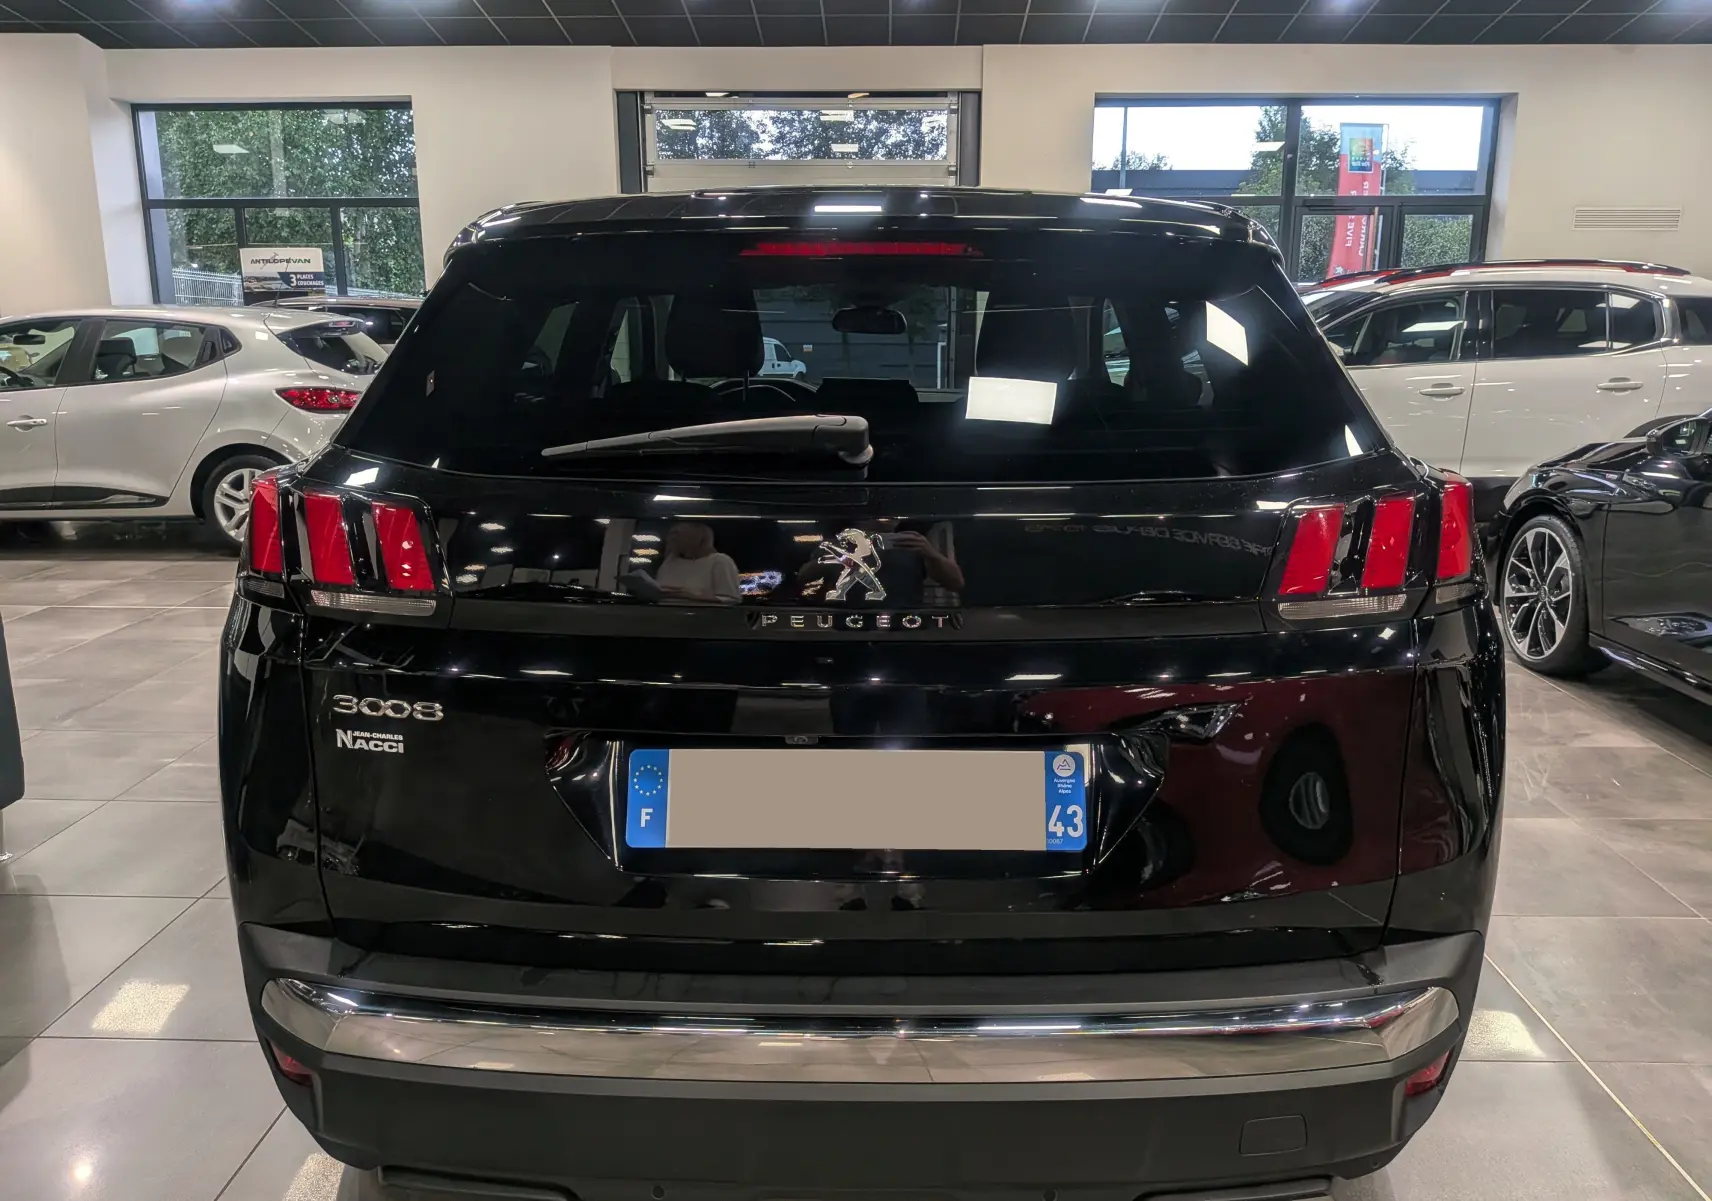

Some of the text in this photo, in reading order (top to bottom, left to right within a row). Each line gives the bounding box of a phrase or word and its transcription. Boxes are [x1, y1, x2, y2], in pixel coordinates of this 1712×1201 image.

[289, 274, 297, 287] 3
[761, 614, 949, 628] PEUGEOT
[333, 694, 444, 721] 3008
[335, 728, 405, 754] NACCI
[352, 731, 403, 741] JEAN-CHARLES
[640, 808, 654, 828] F
[1048, 804, 1084, 838] 43
